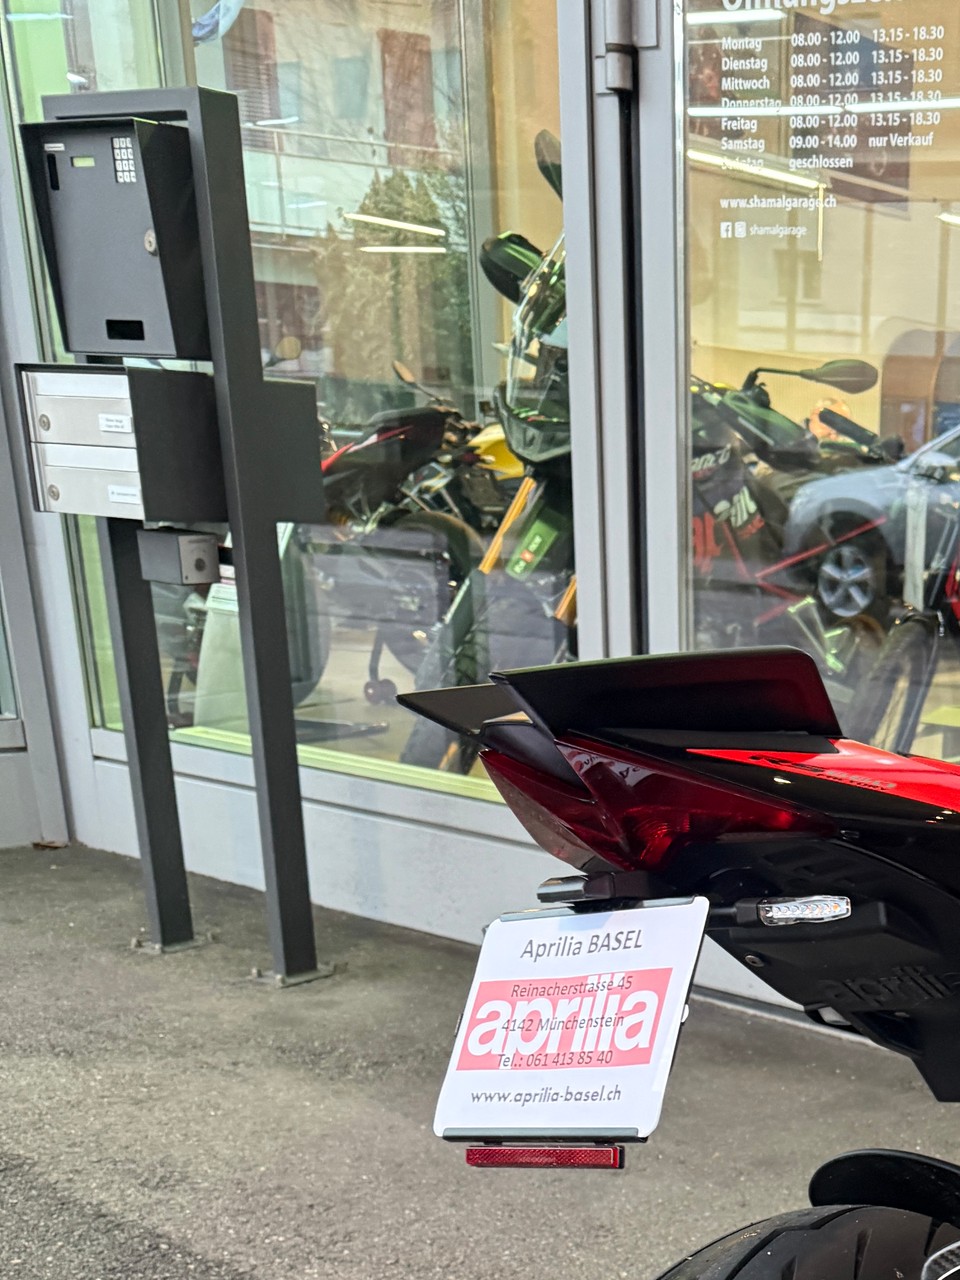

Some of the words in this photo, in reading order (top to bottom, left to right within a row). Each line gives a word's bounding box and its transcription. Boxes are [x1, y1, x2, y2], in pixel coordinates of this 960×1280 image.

[721, 37, 762, 52] Montag
[791, 33, 821, 47] 08.00
[830, 31, 860, 45] 12.00
[872, 28, 903, 43] 13.15
[912, 26, 944, 40] 18.30
[721, 57, 768, 72] Dienstag
[790, 54, 821, 68] 08.00
[829, 51, 860, 66] 12.00
[871, 49, 902, 64] 13.15
[911, 47, 943, 62] 18.30
[721, 76, 770, 91] Mittwoch
[790, 74, 820, 88] 08.00
[829, 72, 859, 87] 12.00
[871, 71, 902, 86] 13.15
[911, 68, 943, 83] 18.30
[790, 94, 820, 108] 08.00
[828, 93, 858, 107] 12.00
[721, 118, 758, 133] Freitag
[789, 116, 819, 130] 08.00
[828, 114, 857, 128] 12.00
[870, 113, 900, 126] 13.15
[909, 112, 941, 125] 18.30
[721, 137, 765, 152] Samstag
[789, 135, 819, 149] 09.00
[828, 134, 857, 148] 14.00
[868, 137, 888, 147] nur
[889, 132, 934, 147] Verkauf
[789, 155, 853, 170] geschlossen
[750, 224, 807, 238] shamalgarage
[520, 936, 583, 963] Aprilia
[587, 929, 643, 955] BASEL
[510, 979, 615, 999] Reinacherstrasse
[616, 975, 633, 990] 45
[467, 972, 660, 1070] aprilia
[501, 1018, 533, 1032] 4142
[536, 1012, 625, 1032] Münchenstein
[498, 1053, 524, 1068] Tel.:
[526, 1053, 549, 1067] 061
[552, 1051, 575, 1065] 413
[577, 1050, 593, 1065] 85
[596, 1049, 614, 1064] 40
[471, 1085, 622, 1107] www.aprilia-basel.ch
